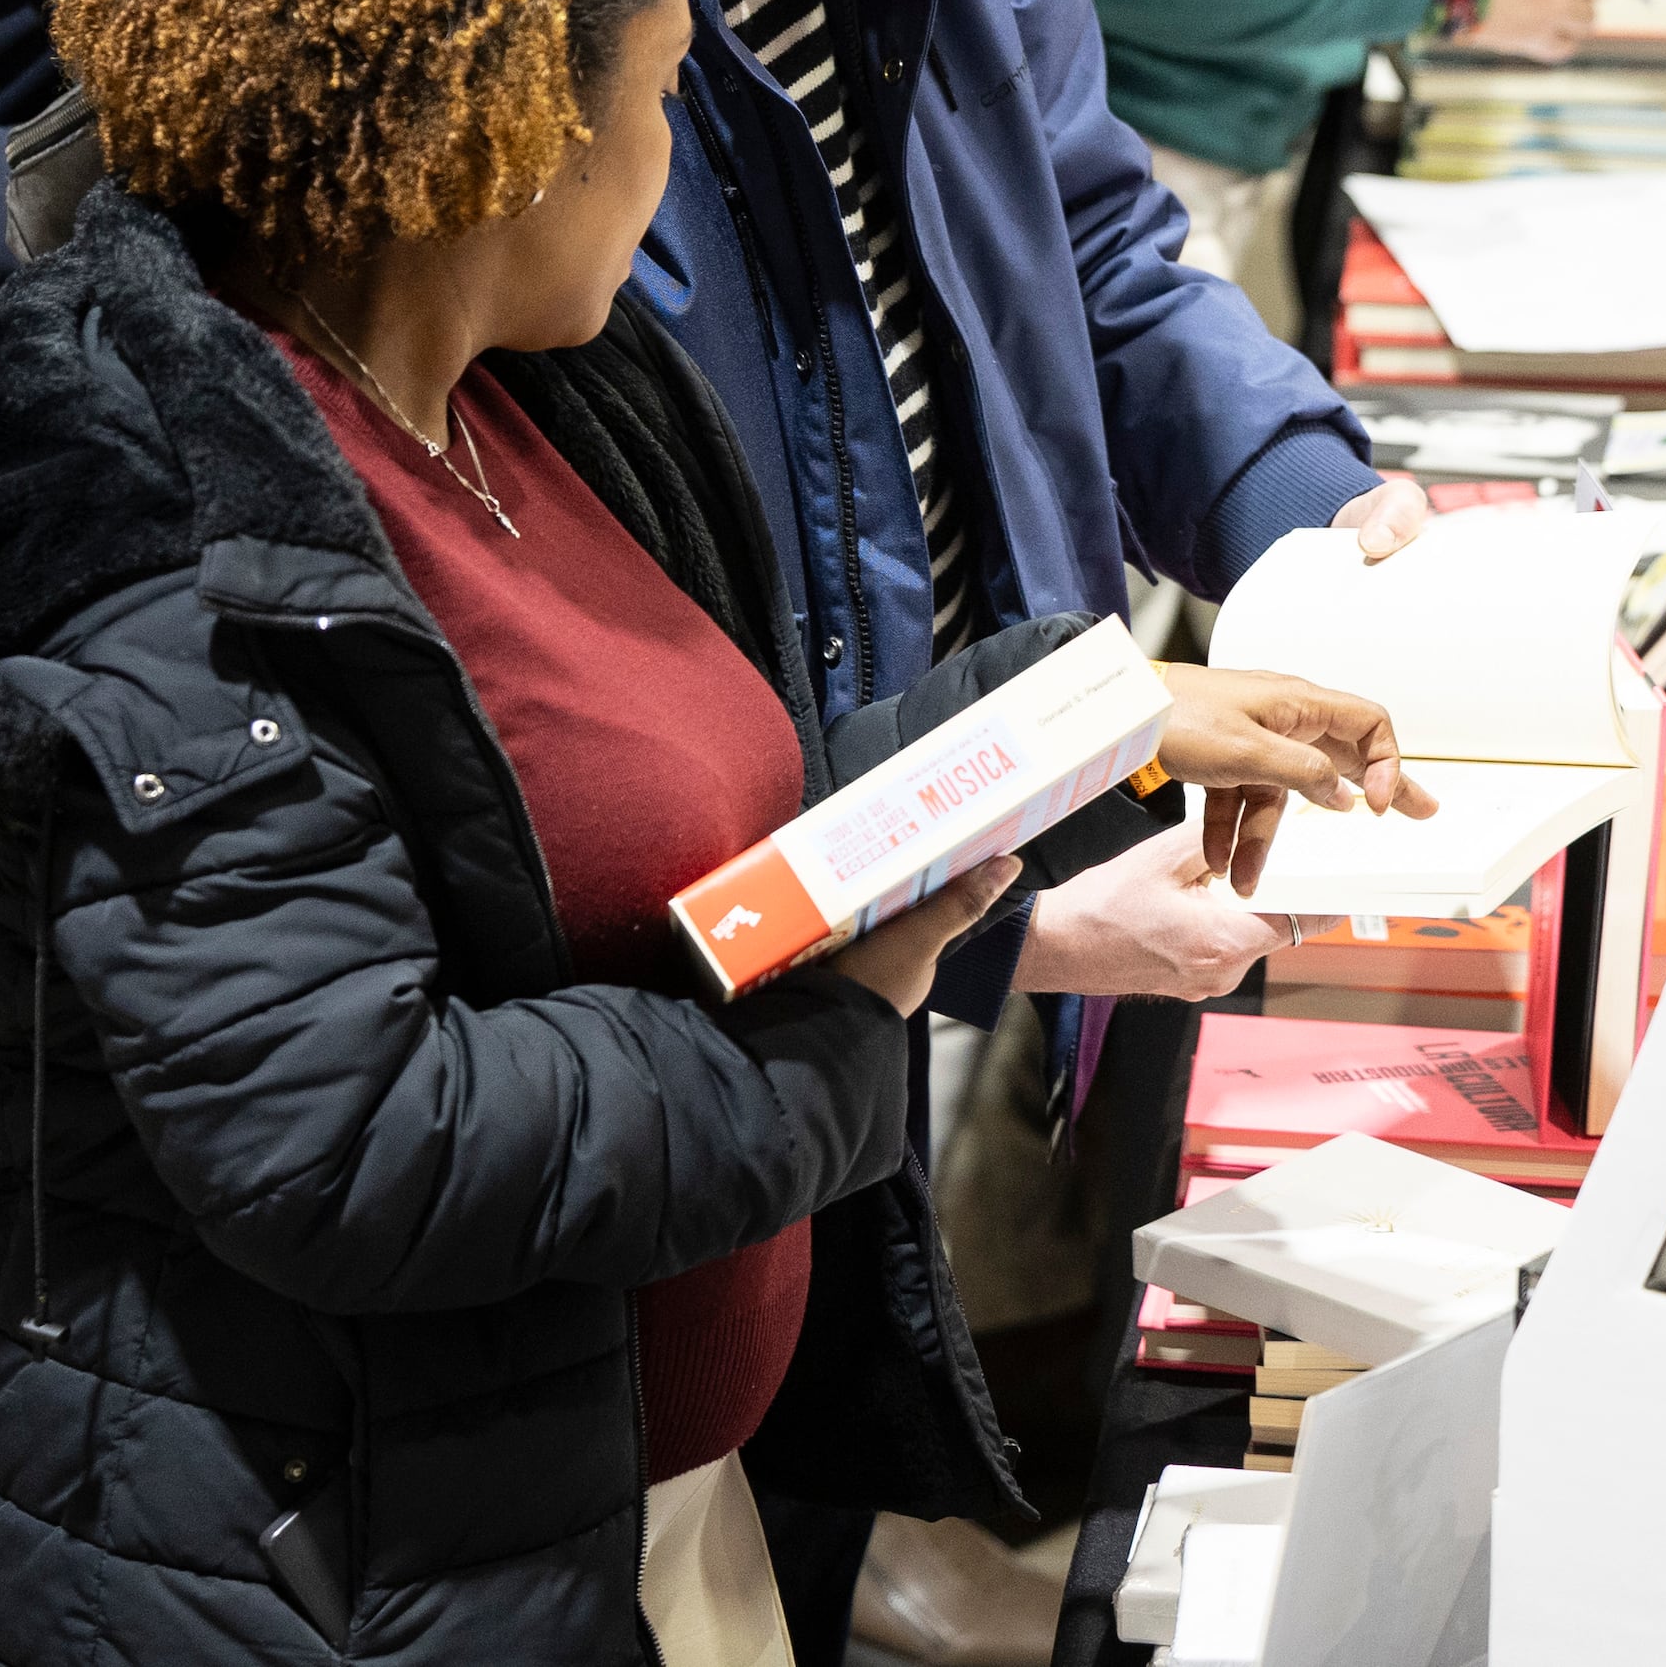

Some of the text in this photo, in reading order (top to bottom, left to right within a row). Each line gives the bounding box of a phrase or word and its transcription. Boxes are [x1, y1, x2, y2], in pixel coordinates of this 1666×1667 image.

[1038, 701, 1072, 727] Donald
[1085, 666, 1128, 695] Passman
[917, 742, 1017, 820] MÚSICA
[1312, 1064, 1434, 1085] INDUSTRIA
[1413, 1042, 1470, 1061] LA
[1446, 1072, 1539, 1132] CULTURA
